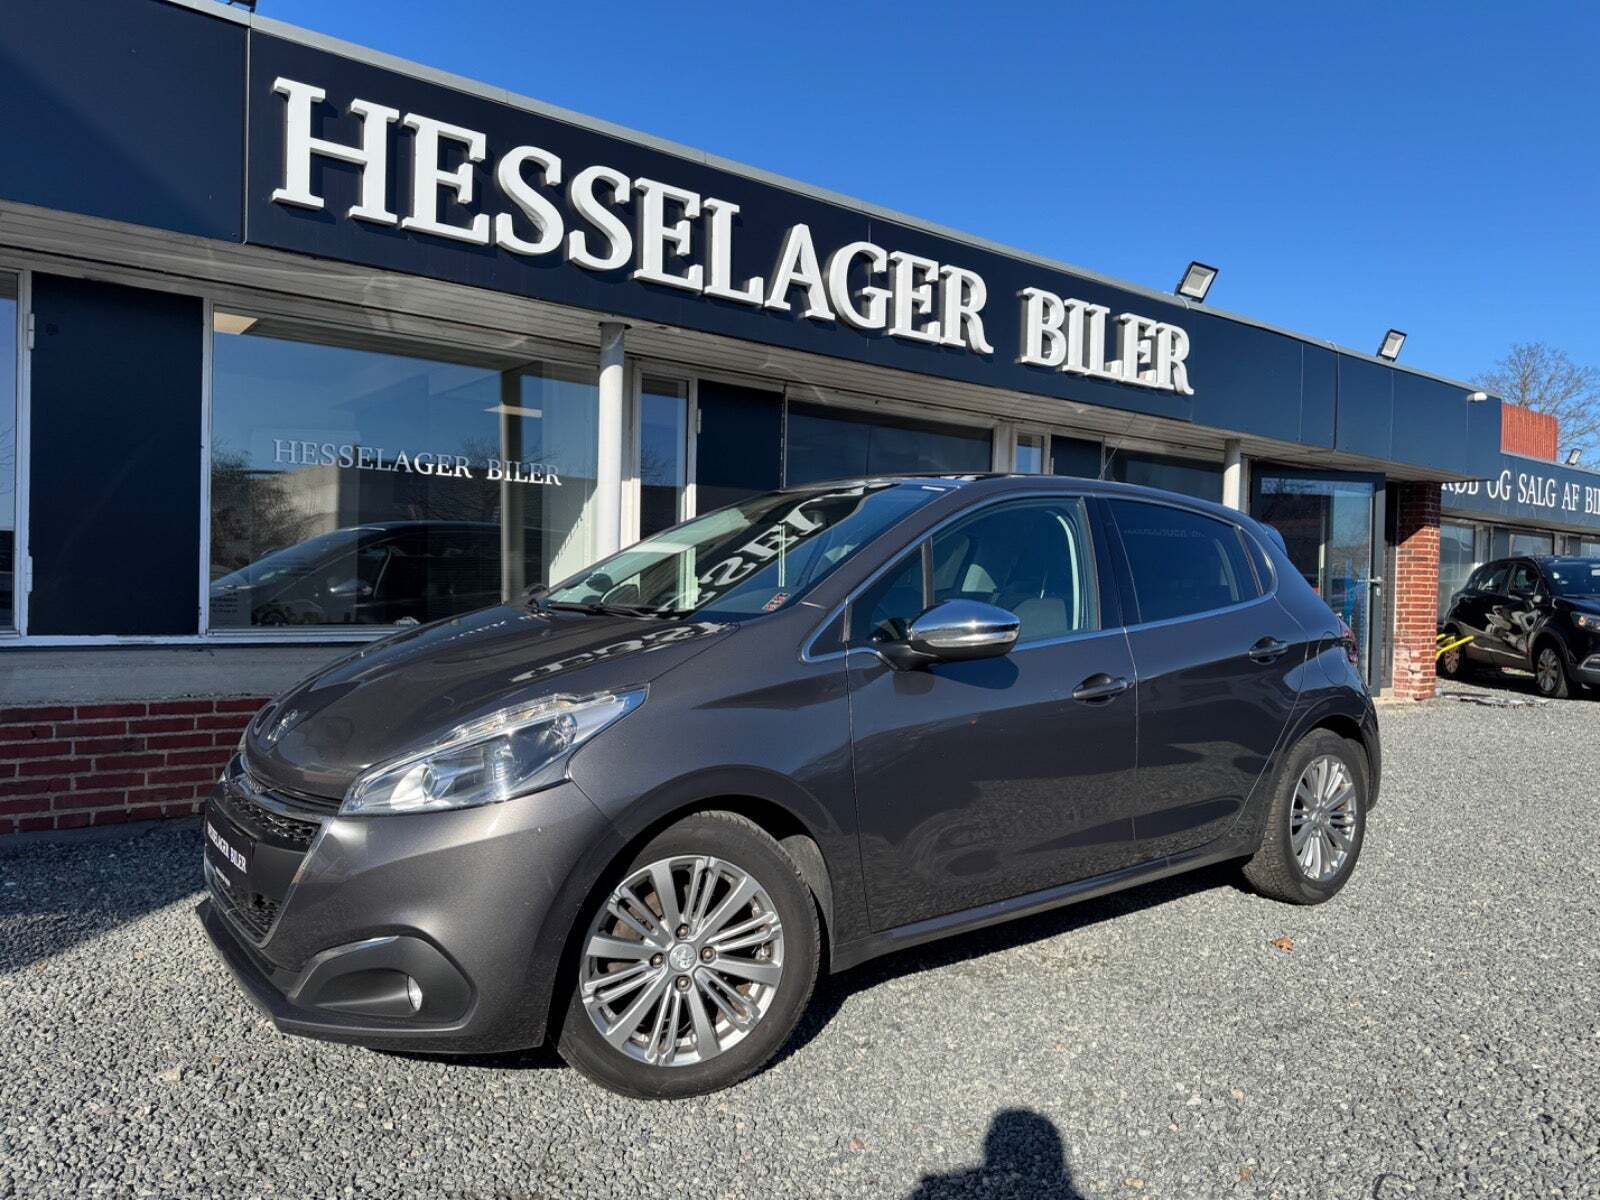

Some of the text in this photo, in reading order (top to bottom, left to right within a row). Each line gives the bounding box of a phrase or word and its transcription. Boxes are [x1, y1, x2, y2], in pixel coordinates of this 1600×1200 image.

[271, 77, 1195, 395] HESSELAGER BILER
[273, 438, 562, 486] HESSELAGER BILER
[1486, 470, 1511, 500] OG
[1518, 473, 1556, 507] SALG
[1562, 482, 1580, 511] AF
